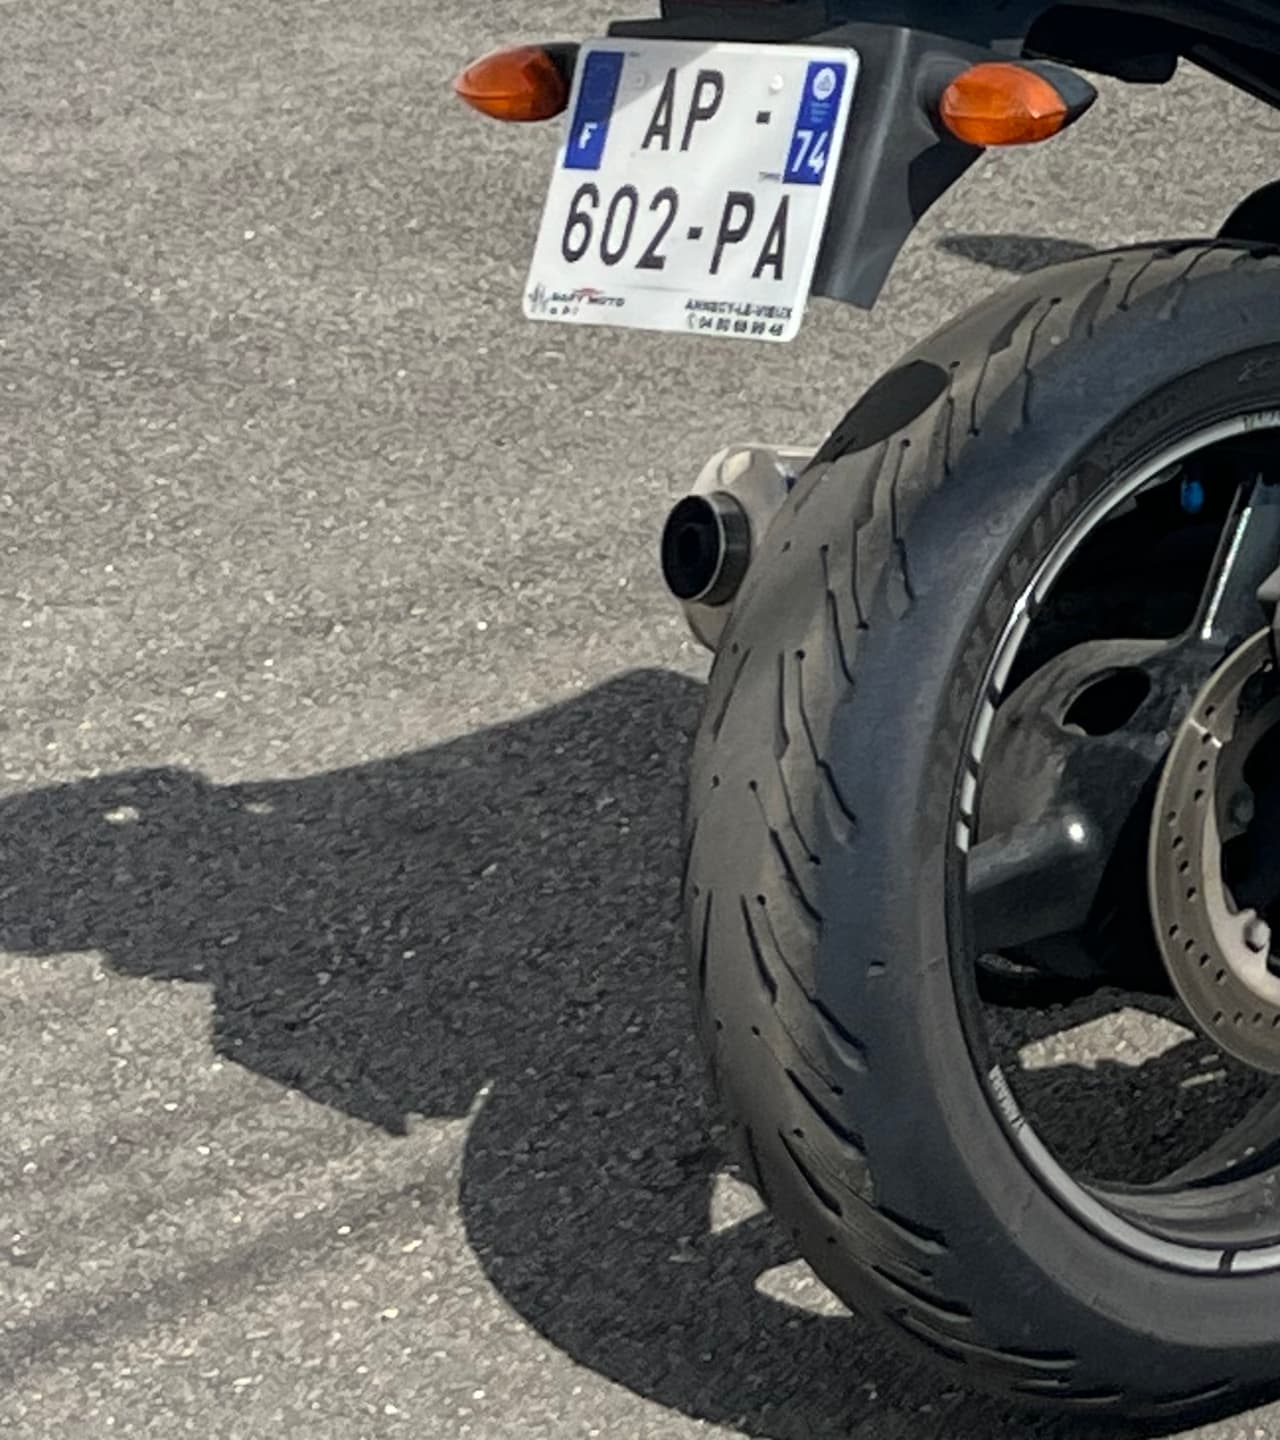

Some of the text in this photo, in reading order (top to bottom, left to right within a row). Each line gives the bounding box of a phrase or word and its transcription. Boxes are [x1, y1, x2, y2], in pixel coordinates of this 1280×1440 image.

[578, 121, 598, 149] F
[791, 130, 828, 175] 74
[560, 182, 791, 281] 602-PA
